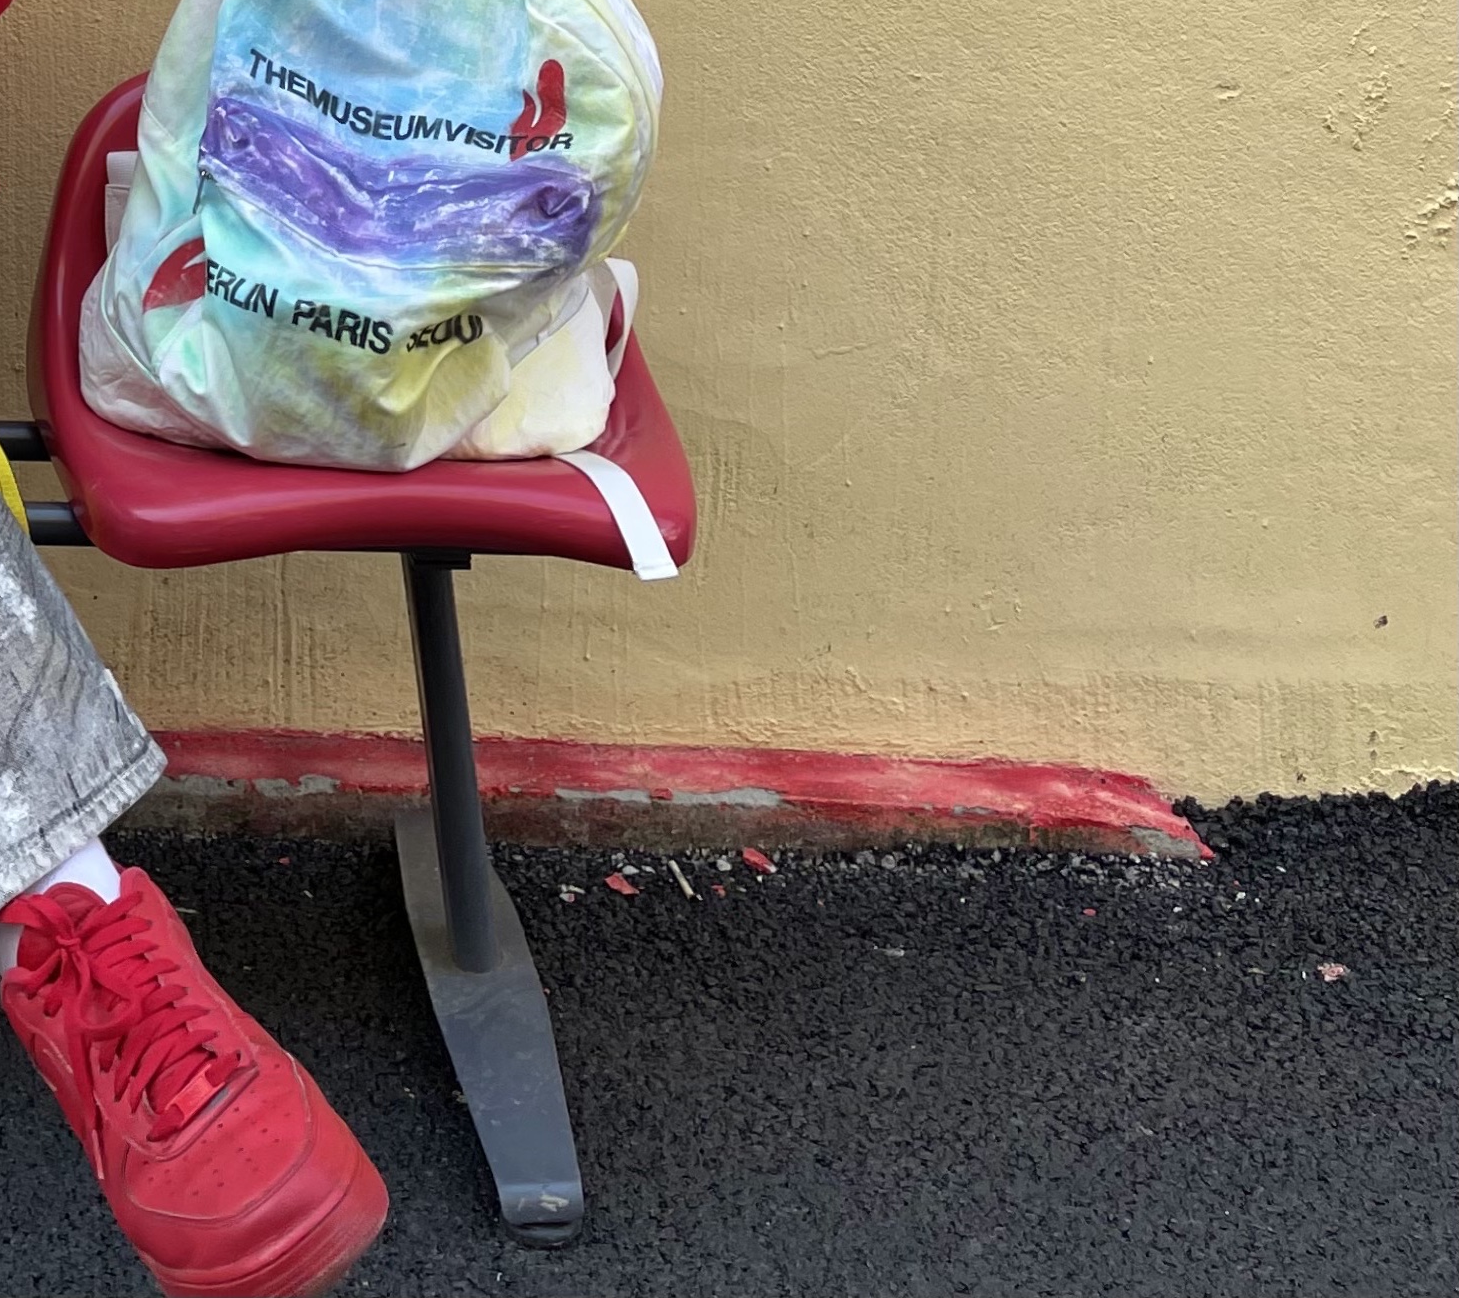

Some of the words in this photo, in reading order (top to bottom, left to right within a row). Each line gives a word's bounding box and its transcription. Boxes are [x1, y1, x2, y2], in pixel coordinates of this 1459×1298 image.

[249, 48, 574, 154] THEMUSEUMVISITOR
[206, 256, 279, 319] ERLIN
[291, 299, 393, 355] PARIS
